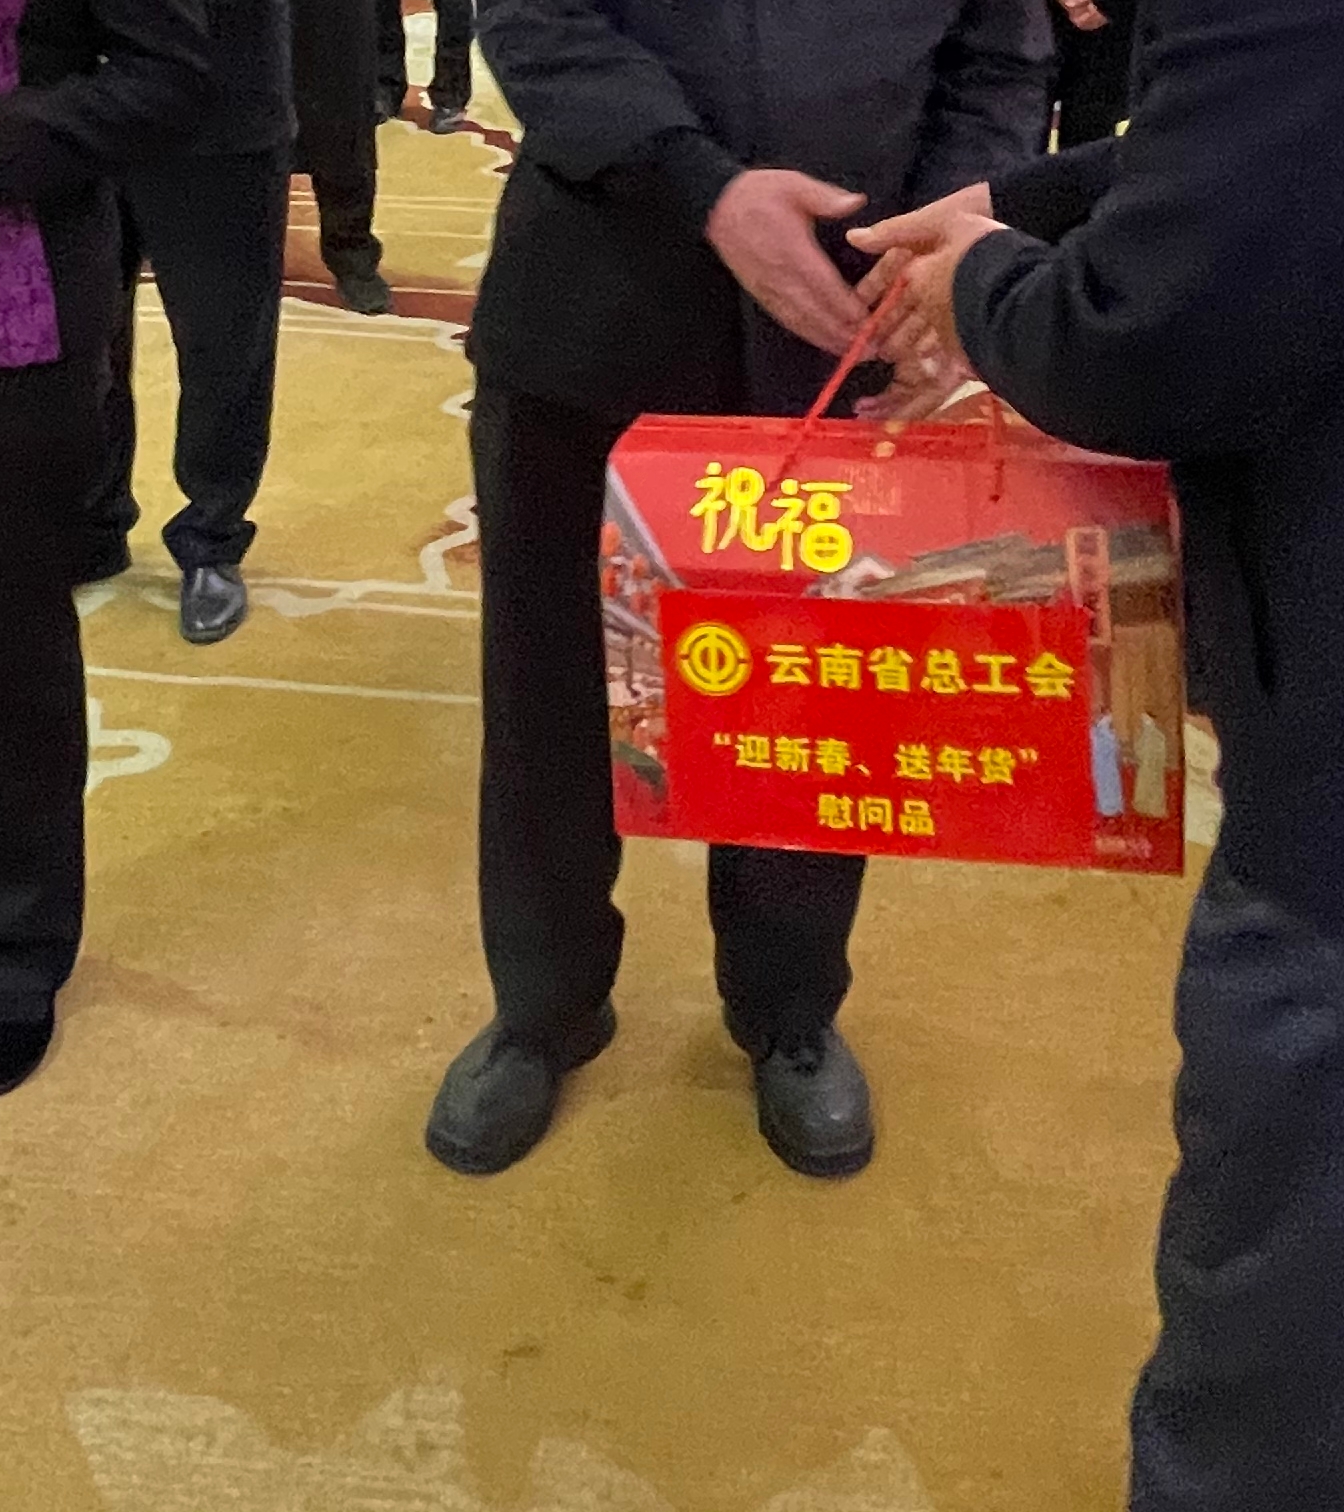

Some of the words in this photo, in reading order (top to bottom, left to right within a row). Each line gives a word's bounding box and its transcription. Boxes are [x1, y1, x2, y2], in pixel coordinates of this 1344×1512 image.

[689, 461, 854, 573] 祝福
[766, 642, 1076, 701] 云南省总工会
[816, 792, 936, 837] 慰问品
